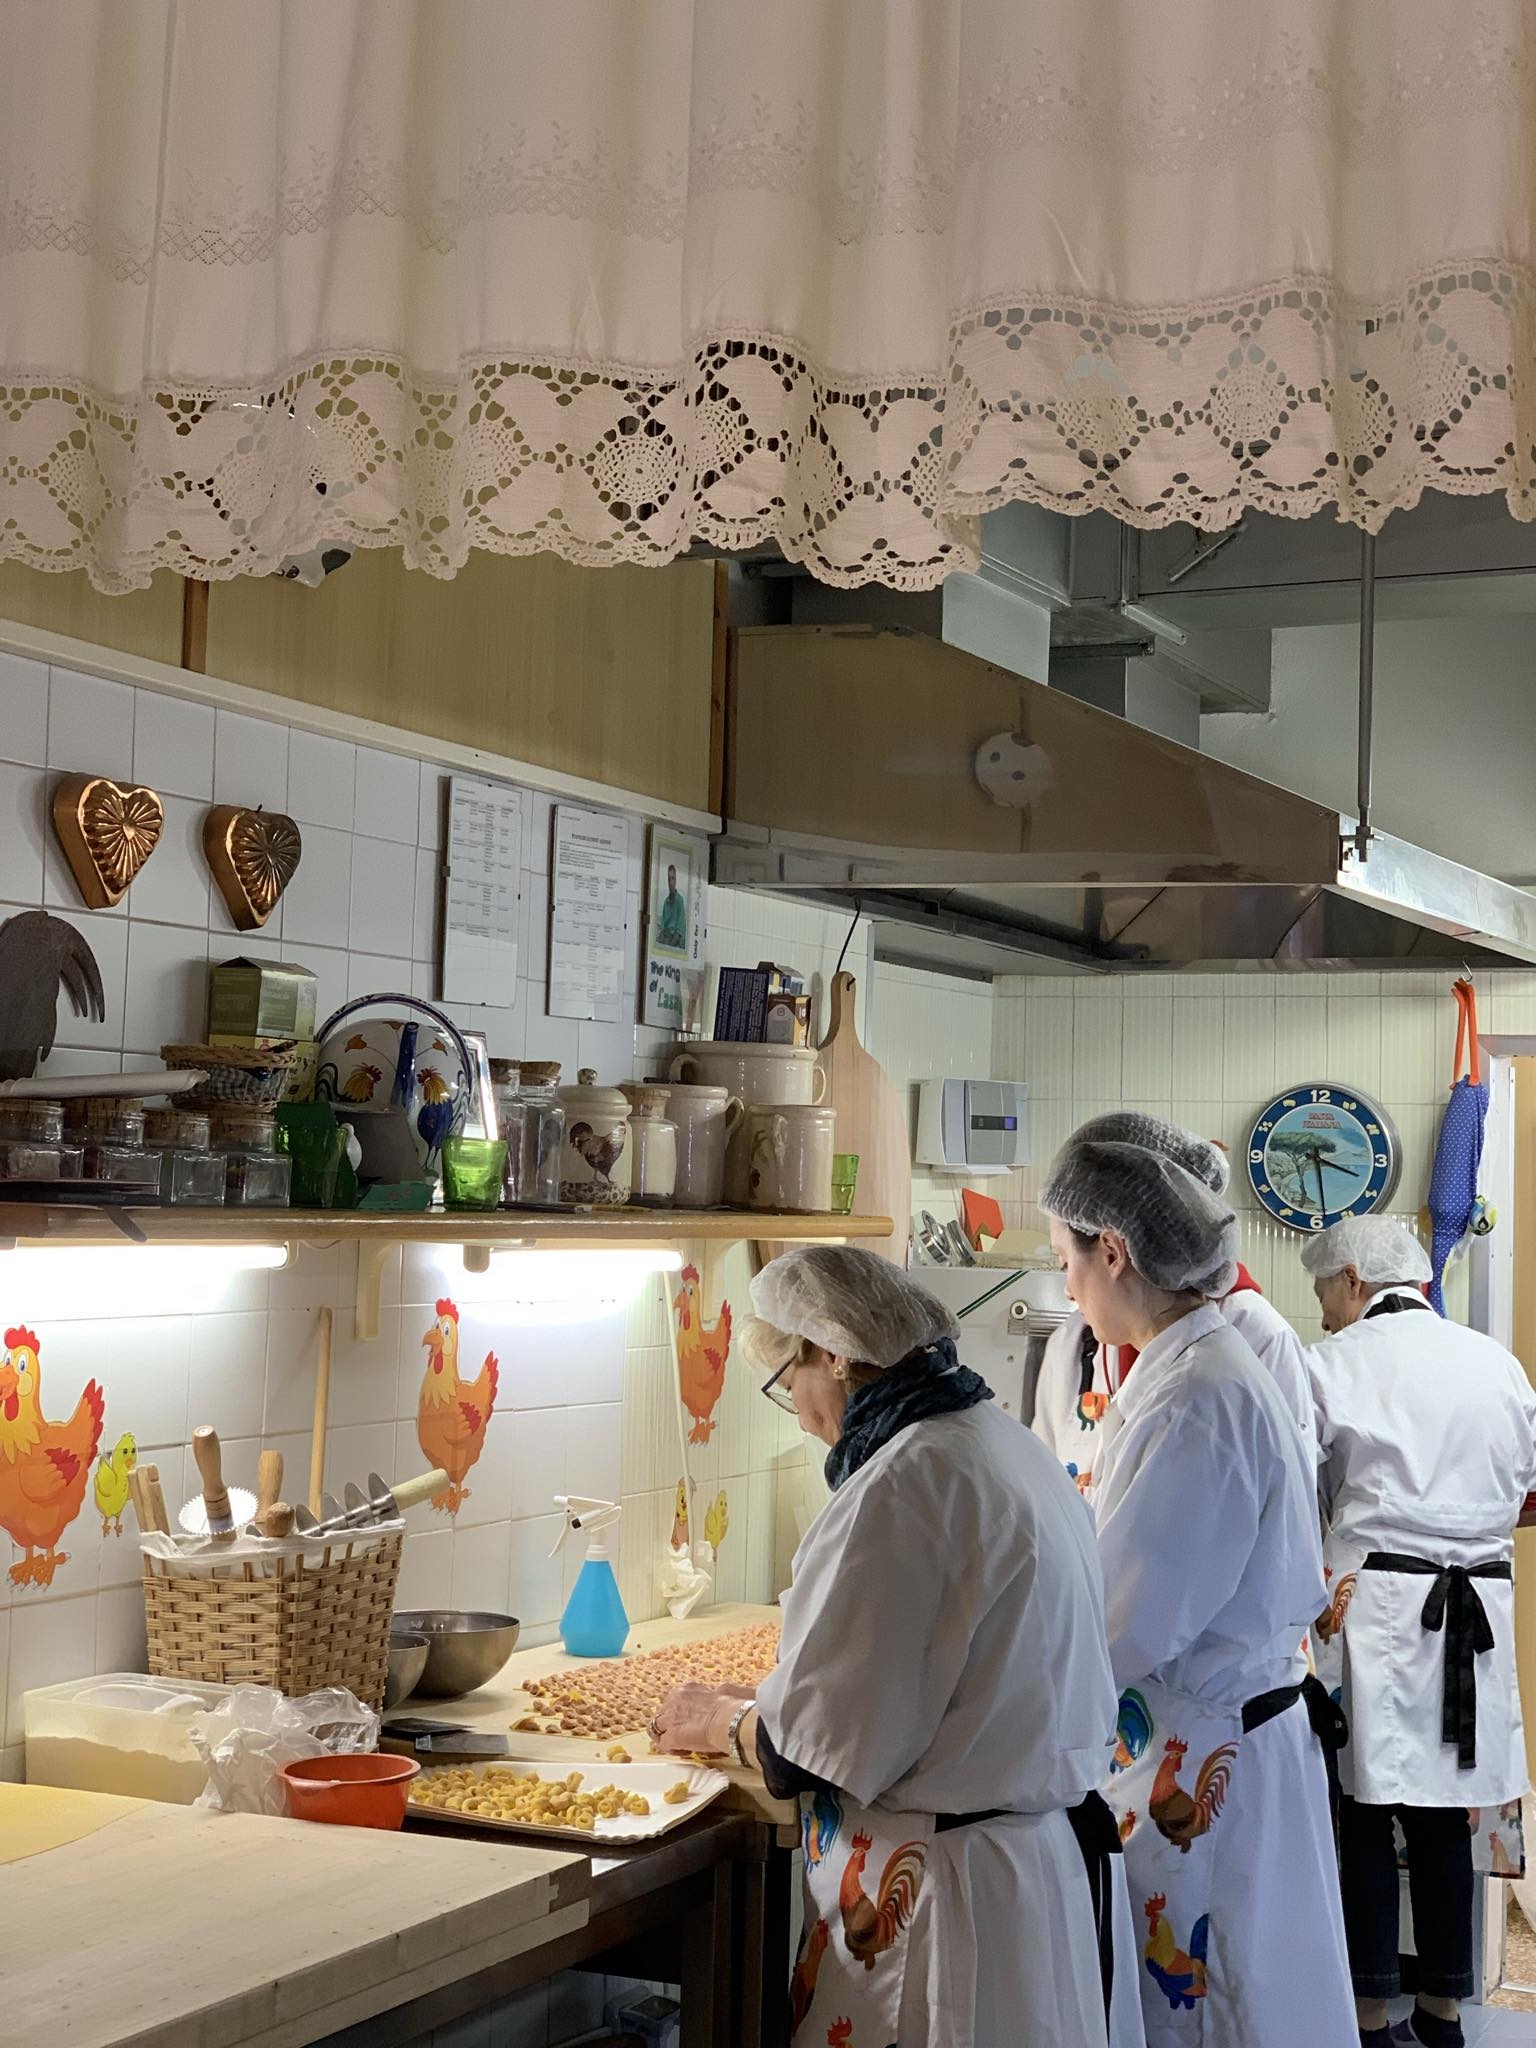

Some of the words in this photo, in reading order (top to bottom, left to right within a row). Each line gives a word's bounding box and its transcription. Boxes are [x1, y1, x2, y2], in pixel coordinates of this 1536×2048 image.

[650, 961, 664, 976] The
[665, 964, 681, 983] King
[649, 978, 659, 992] of
[1310, 1089, 1331, 1103] 12
[1308, 1112, 1334, 1120] PASTA
[1302, 1120, 1341, 1129] ITALIANA
[1250, 1149, 1264, 1163] 9
[1374, 1153, 1388, 1167] 3
[1309, 1215, 1323, 1229] 6
